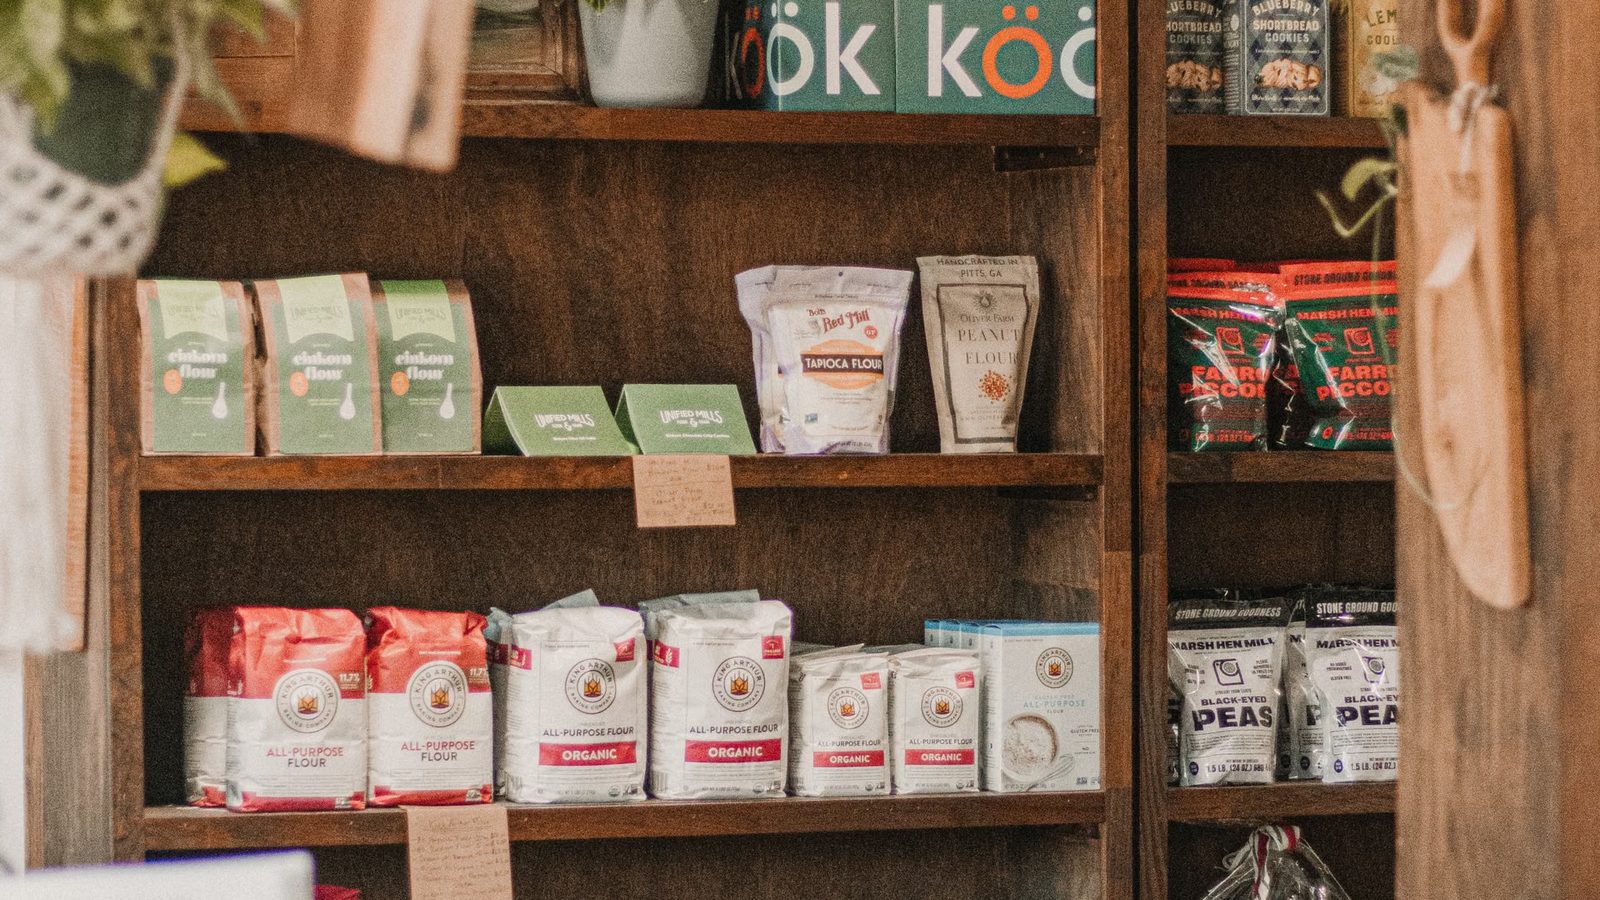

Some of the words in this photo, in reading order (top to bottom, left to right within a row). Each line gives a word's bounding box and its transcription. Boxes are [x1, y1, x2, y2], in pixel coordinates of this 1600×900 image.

[1252, 0, 1320, 16] BLUEBERRY
[1367, 9, 1398, 27] LEM
[1253, 20, 1320, 31] SHORTBREAD
[1170, 34, 1212, 45] COOKIES
[1265, 33, 1309, 42] COOKIES
[1297, 310, 1347, 320] MARSH
[822, 314, 845, 334] Red
[958, 328, 1020, 341] PEANUT
[168, 349, 228, 363] einkorn
[292, 351, 352, 366] einkorn
[395, 351, 454, 366] einkorn
[966, 352, 1018, 364] FLOUR
[805, 358, 849, 369] TAPIOCA
[852, 358, 883, 370] FLOUR
[181, 364, 218, 378] flour
[304, 367, 343, 380] flour
[407, 367, 444, 380] flour
[1328, 365, 1388, 381] FARR
[660, 410, 695, 424] UNIFIED
[695, 410, 723, 424] MILLS
[1176, 608, 1202, 620] STONE
[1202, 608, 1238, 618] GROUND
[1237, 607, 1282, 617] GOODNESS
[1316, 602, 1343, 614] STONE
[1345, 602, 1379, 613] GROUND
[1216, 640, 1243, 650] HEN
[1244, 637, 1276, 648] MILL
[1363, 639, 1390, 648] HEN
[570, 666, 586, 685] KING
[588, 662, 613, 683] ARTHUR
[718, 663, 731, 683] KING
[733, 660, 763, 682] ARTHUR
[415, 671, 432, 694] KING
[434, 668, 463, 693] ARTHUR
[1023, 699, 1085, 709] ALL-PURPOSE
[1201, 695, 1267, 706] BLACK-EYED
[1191, 705, 1273, 732] PEAS
[1336, 705, 1397, 728] PEA
[543, 728, 606, 737] ALL-PURPOSE
[607, 726, 635, 736] FLOUR
[690, 726, 752, 735] ALL-PURPOSE
[753, 723, 779, 734] FLOUR
[401, 741, 476, 752] ALL-PURPOSE
[818, 740, 861, 748] ALL-PURPOSE
[266, 747, 344, 757] ALL-PURPOSE
[421, 752, 458, 762] FLOUR
[562, 749, 618, 761] ORGANIC
[708, 746, 763, 758] ORGANIC
[921, 753, 962, 761] ORGANIC
[287, 758, 327, 768] FLOUR
[830, 755, 871, 764] ORGANIC
